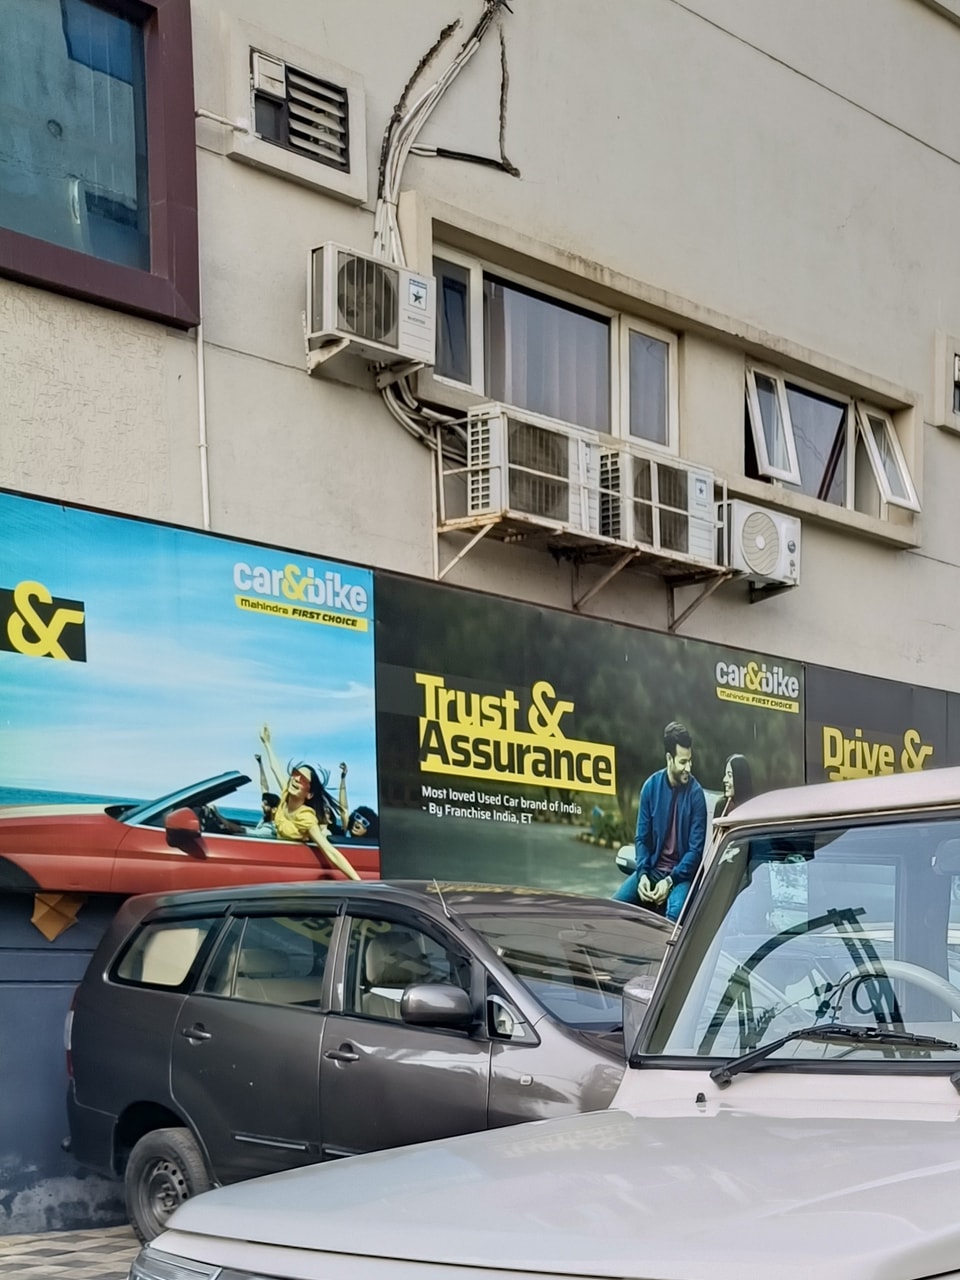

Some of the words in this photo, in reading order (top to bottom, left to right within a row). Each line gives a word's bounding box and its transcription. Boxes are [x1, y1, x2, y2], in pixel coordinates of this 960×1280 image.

[233, 562, 368, 613] car&bike
[240, 598, 289, 615] Mahindra
[292, 608, 321, 621] FIRST
[322, 614, 358, 627] CHOICE
[716, 661, 799, 698] car&bike
[415, 672, 519, 729] Trust
[527, 681, 574, 739] &
[751, 697, 769, 706] FIRST
[770, 700, 793, 710] CHOICE
[420, 722, 612, 787] Assurance
[823, 726, 895, 775] Drive
[901, 729, 934, 773] &
[421, 786, 447, 799] Most
[449, 789, 475, 803] loved
[478, 793, 501, 805] Used
[503, 795, 519, 807] Car
[520, 797, 548, 811] brand
[549, 800, 559, 812] of
[560, 803, 582, 815] India
[429, 803, 443, 817] By
[445, 804, 491, 820] Franchise
[493, 811, 520, 824] India,
[521, 813, 533, 825] ET
